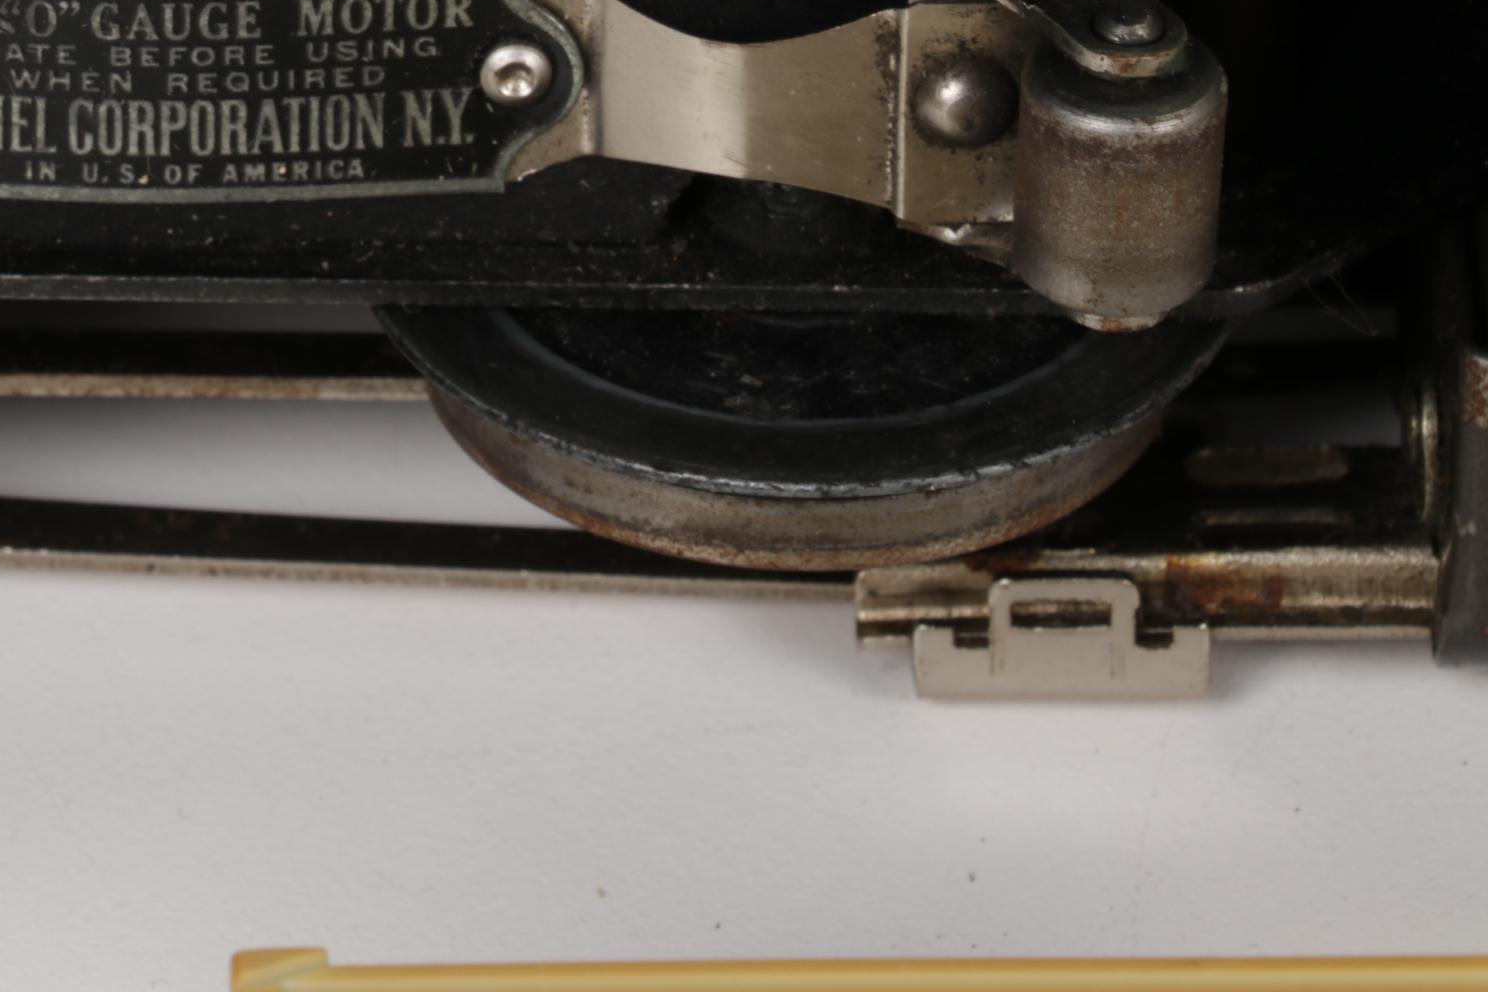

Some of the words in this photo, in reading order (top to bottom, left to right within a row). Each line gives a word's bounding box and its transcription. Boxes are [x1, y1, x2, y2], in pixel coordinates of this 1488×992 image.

[91, 0, 261, 41] GAUGE
[110, 44, 275, 67] BEFORE
[306, 37, 438, 62] USING
[12, 68, 132, 93] WHEN
[167, 66, 385, 94] REQUIRED
[68, 91, 384, 156] CORPORATION
[403, 85, 474, 147] N.Y.
[25, 162, 56, 182] IN
[164, 164, 203, 184] OF
[222, 158, 364, 182] AMERICA
